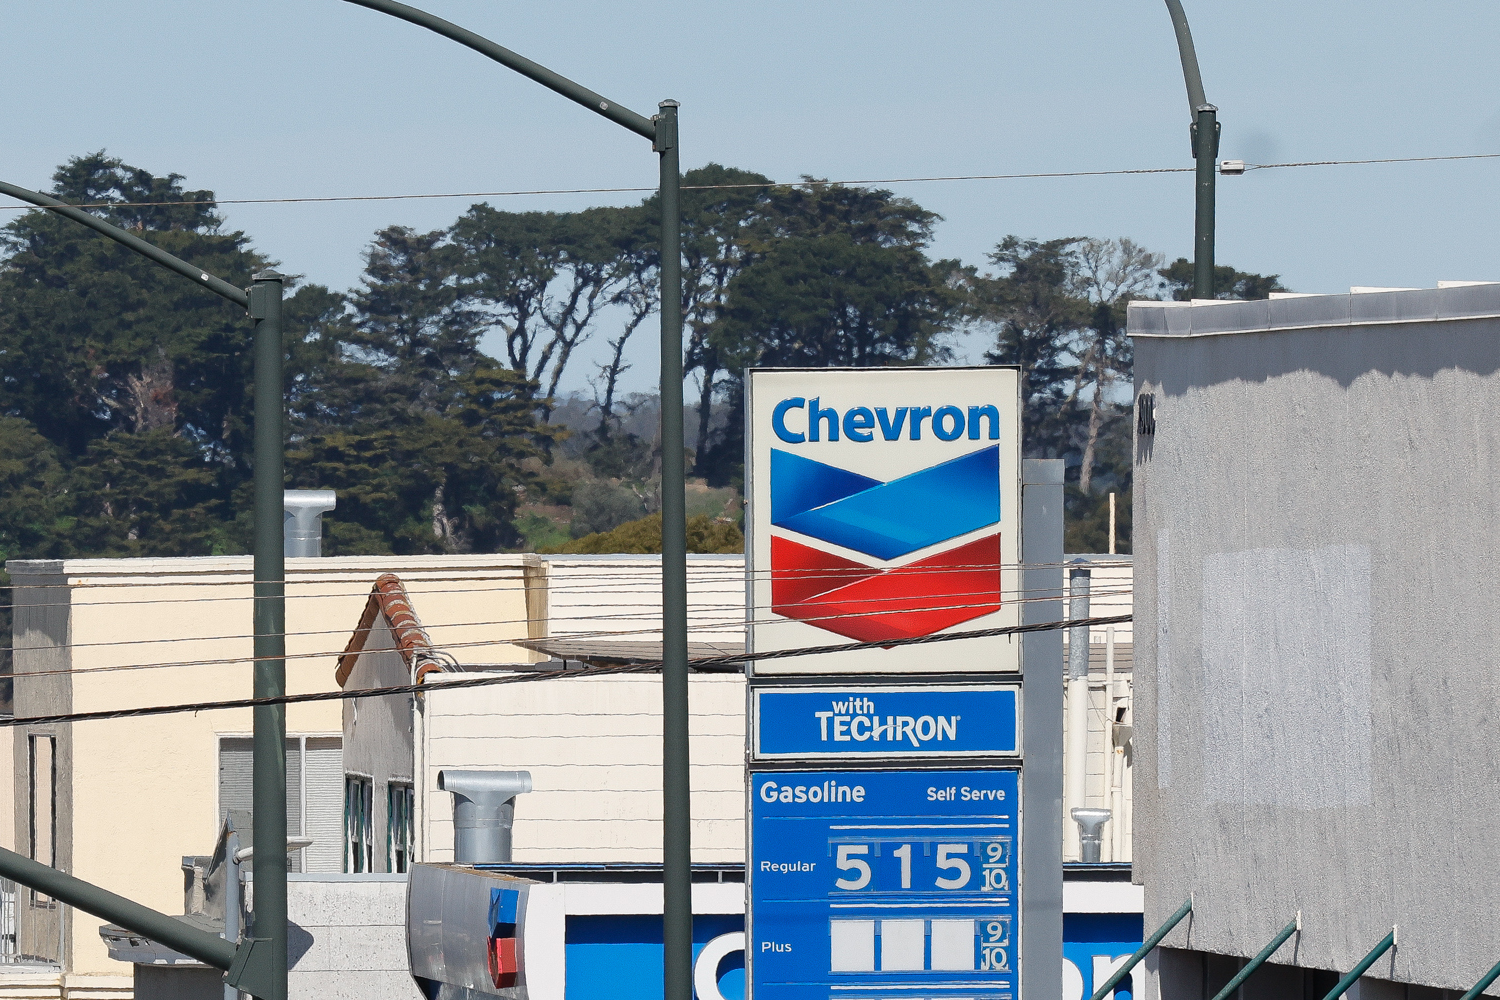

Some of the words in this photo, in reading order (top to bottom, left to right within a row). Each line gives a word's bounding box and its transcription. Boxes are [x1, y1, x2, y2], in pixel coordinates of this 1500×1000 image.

[771, 396, 1000, 444] Chevron
[832, 697, 875, 714] with
[760, 780, 866, 803] Gasoline
[927, 787, 957, 801] Self
[961, 788, 1006, 801] Serve
[760, 861, 816, 874] Regular
[761, 941, 792, 953] Plus
